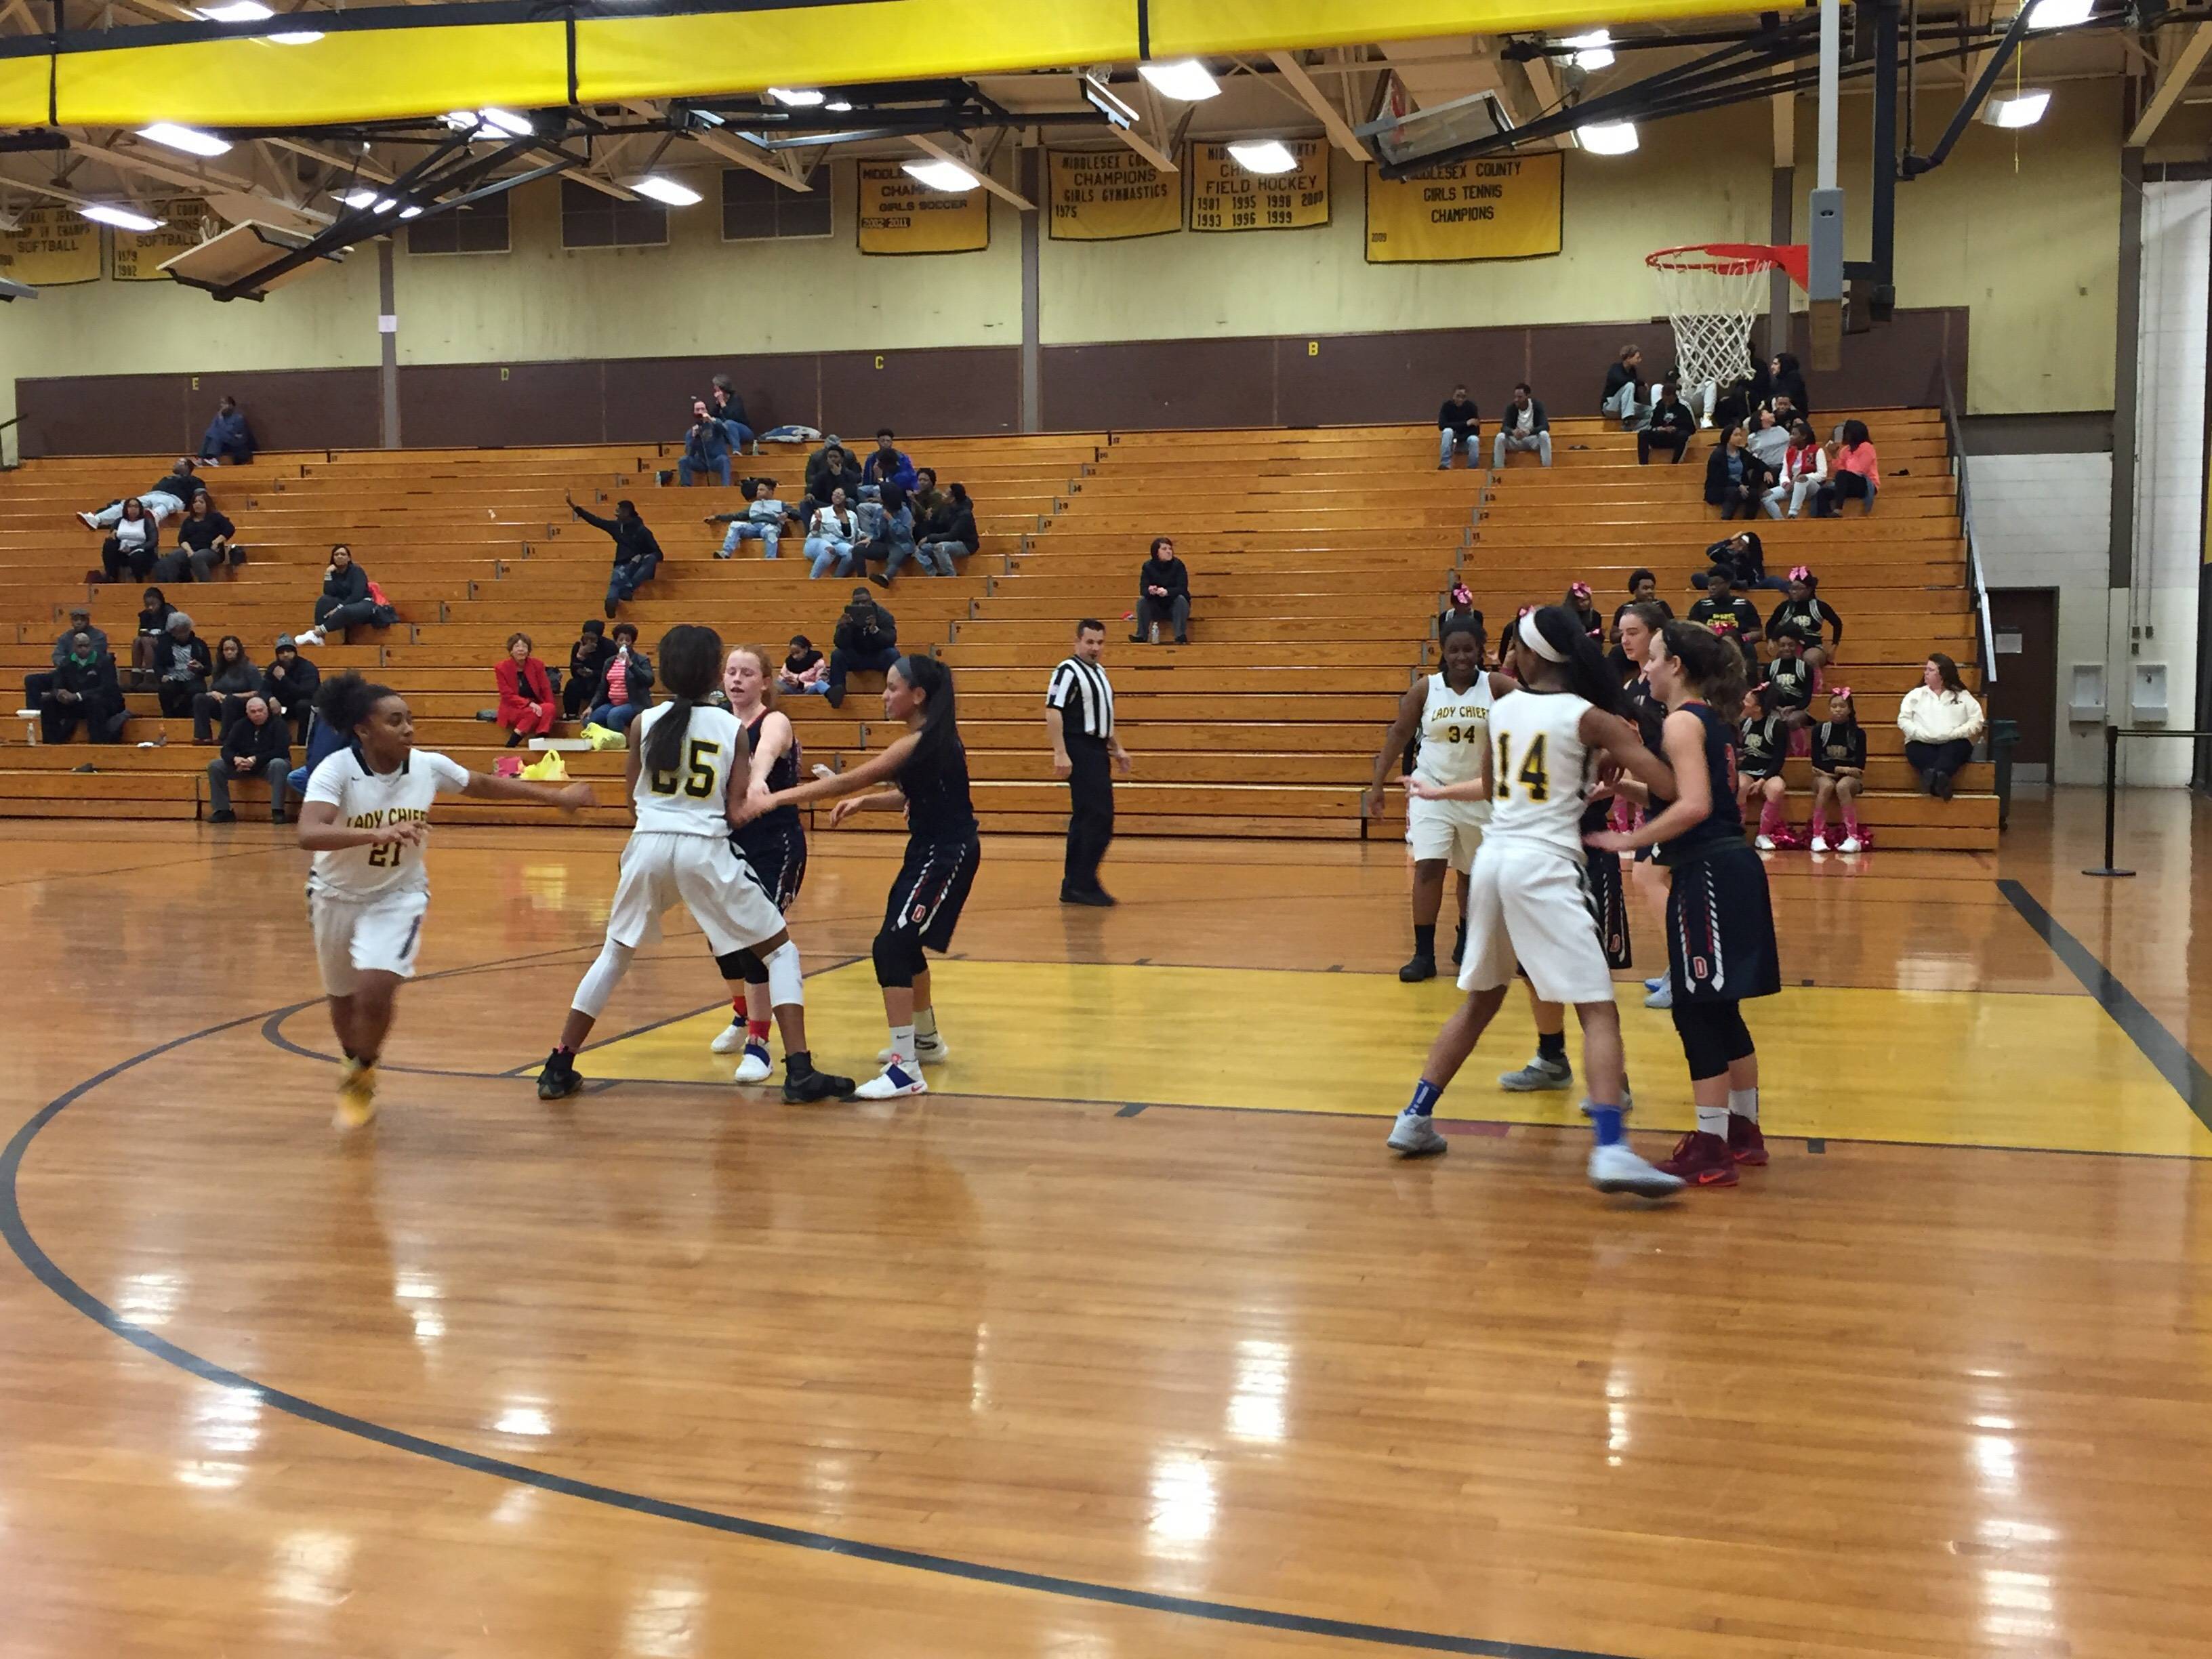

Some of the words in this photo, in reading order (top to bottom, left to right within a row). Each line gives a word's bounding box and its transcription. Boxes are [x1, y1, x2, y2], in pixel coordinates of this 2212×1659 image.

[1476, 161, 1521, 177] COUNTY
[1074, 170, 1156, 186] CHAMPIONS
[1206, 179, 1250, 194] FIELD
[1258, 175, 1317, 191] HOCKEY
[1064, 189, 1094, 203] GIRLS
[1102, 184, 1167, 202] GYMNASTICS
[1424, 186, 1456, 202] GIRLS
[1462, 184, 1502, 200] TENNIS
[1431, 206, 1494, 223] CHAMPIONS
[18, 239, 79, 253] SOFTBALL
[136, 234, 199, 247] SOFTBALL
[1309, 342, 1318, 356] B
[876, 356, 884, 369] C
[501, 368, 509, 381] D
[192, 377, 199, 390] E
[1431, 707, 1456, 722] LADY
[1459, 706, 1489, 720] CHIEF
[1448, 725, 1475, 744] 34
[1494, 730, 1550, 803] 14
[346, 810, 384, 829] LADY
[369, 840, 402, 867] 21
